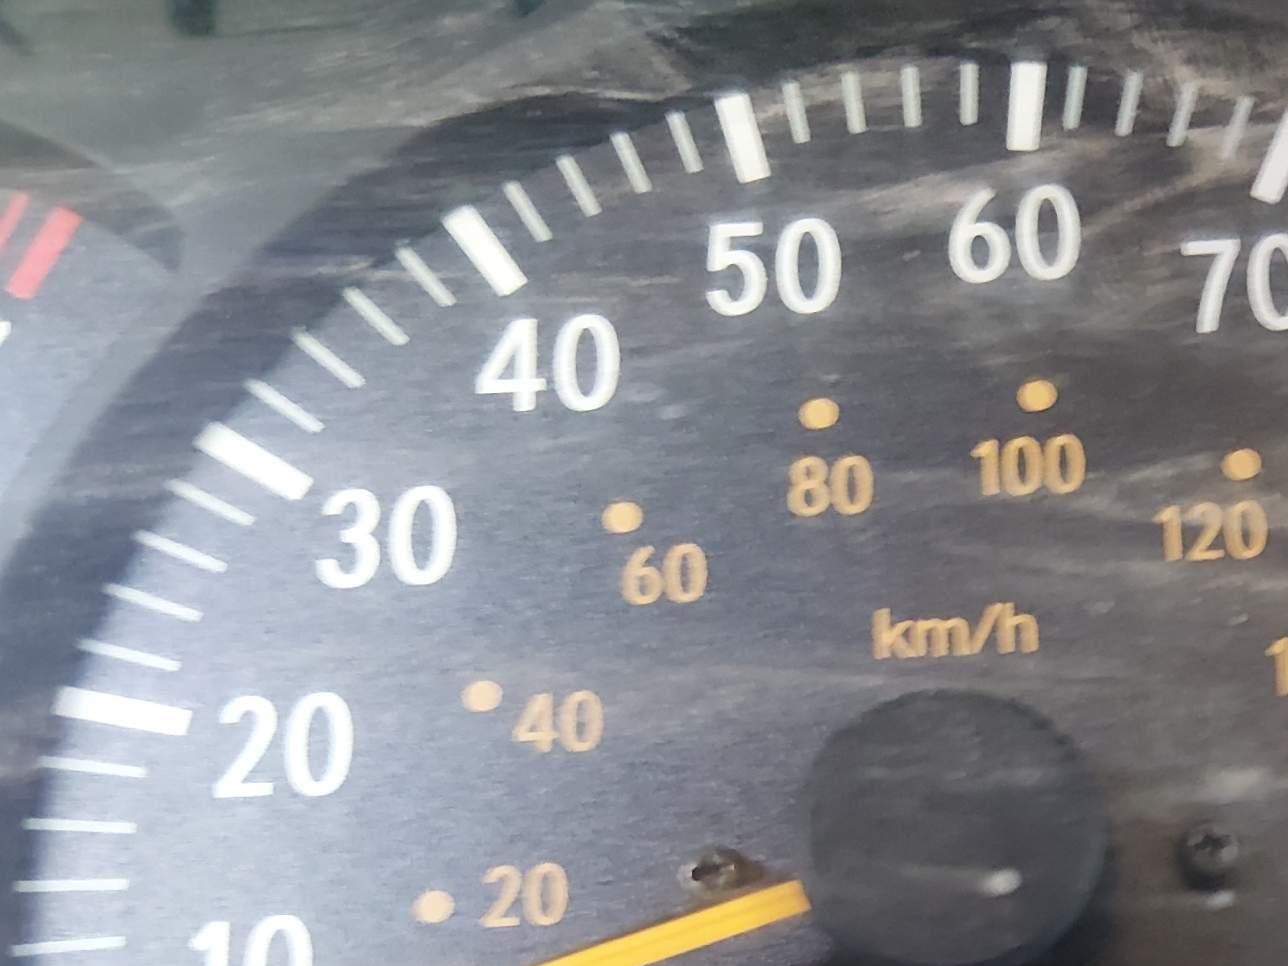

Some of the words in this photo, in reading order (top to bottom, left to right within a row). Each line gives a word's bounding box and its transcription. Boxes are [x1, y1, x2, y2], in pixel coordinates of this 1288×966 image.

[705, 218, 843, 315] 50
[947, 184, 1083, 285] 60
[473, 314, 622, 412] 40
[787, 456, 874, 517] 80
[970, 433, 1085, 497] 100
[314, 484, 459, 590] 30
[1152, 500, 1269, 563] 120
[620, 543, 708, 605] 60
[871, 603, 1040, 660] km/h
[210, 690, 355, 799] 20
[512, 689, 604, 753] 40
[479, 862, 569, 927] 20
